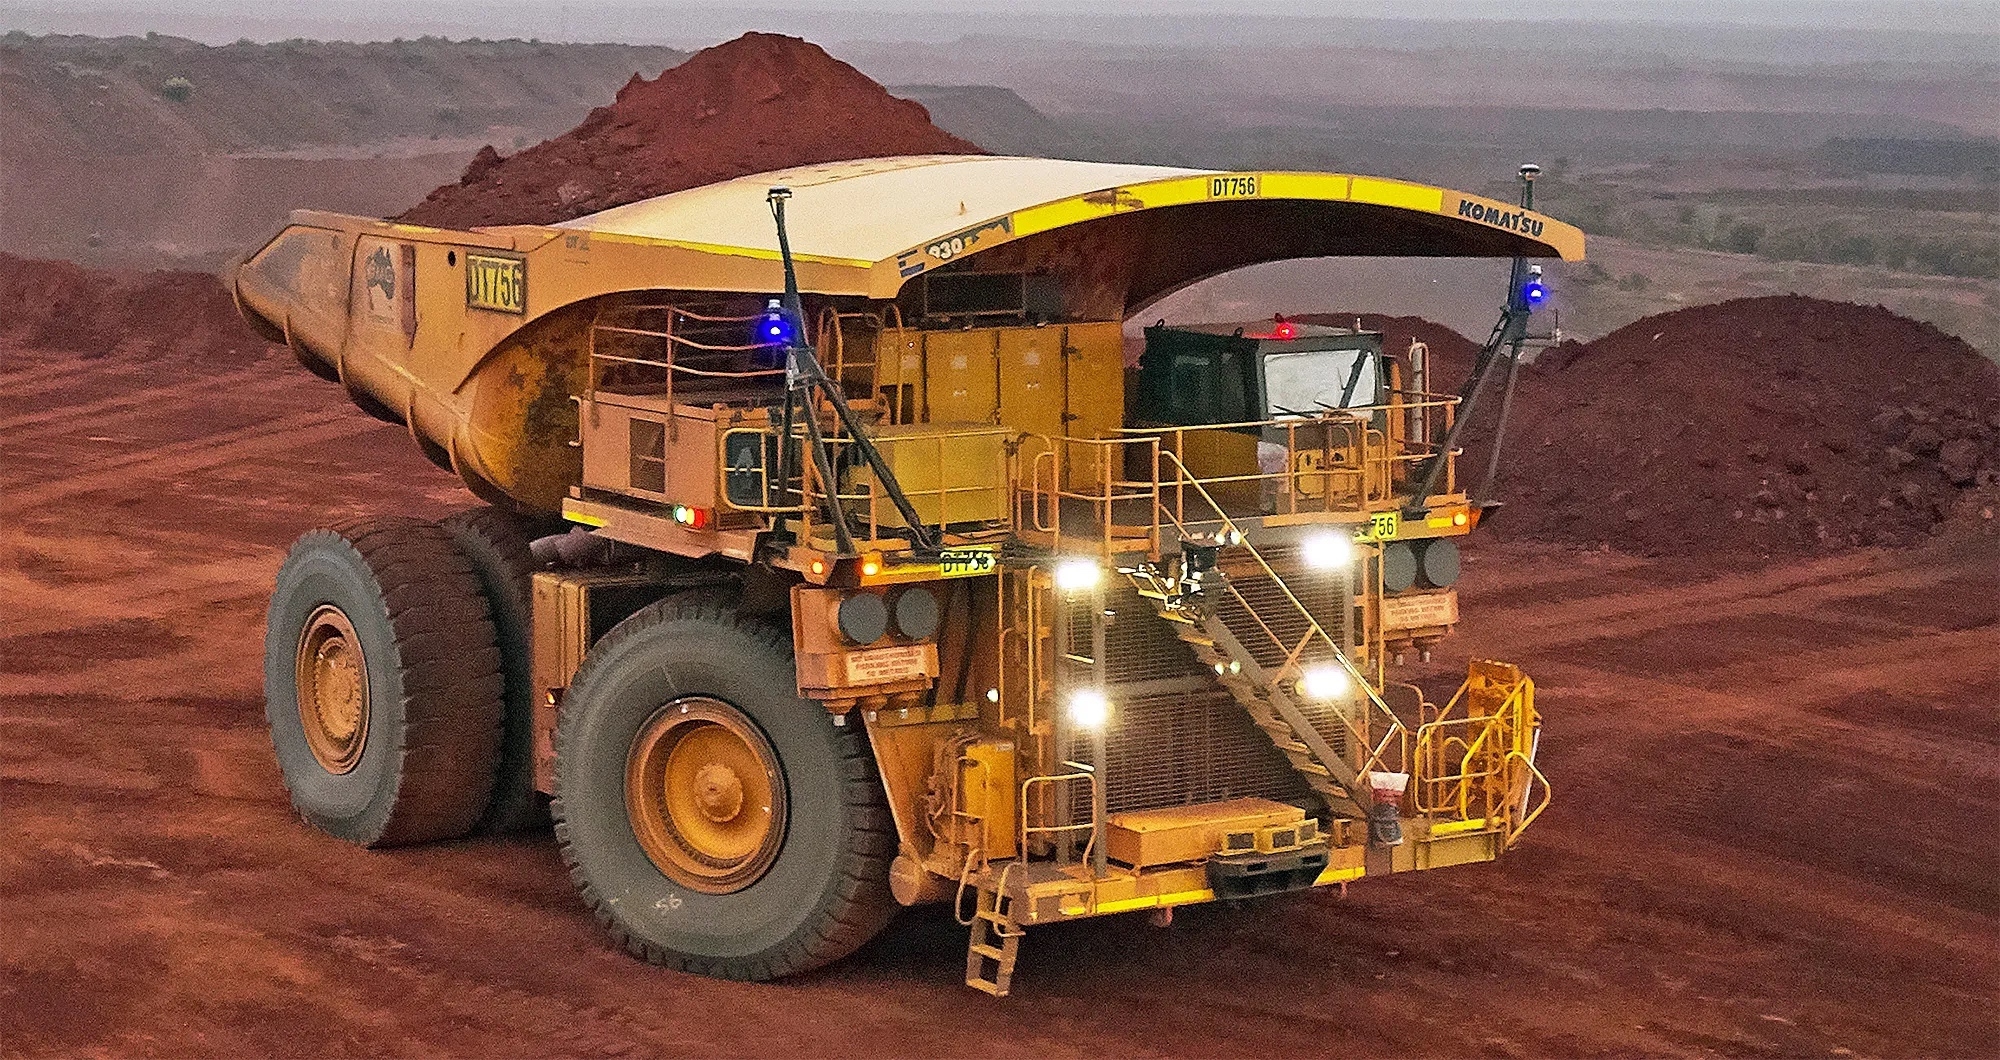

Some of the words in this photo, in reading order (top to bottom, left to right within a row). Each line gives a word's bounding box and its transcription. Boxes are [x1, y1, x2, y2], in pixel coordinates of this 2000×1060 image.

[1213, 177, 1255, 196] DT756
[1458, 200, 1544, 237] KOMATSU
[469, 259, 523, 307] DT756
